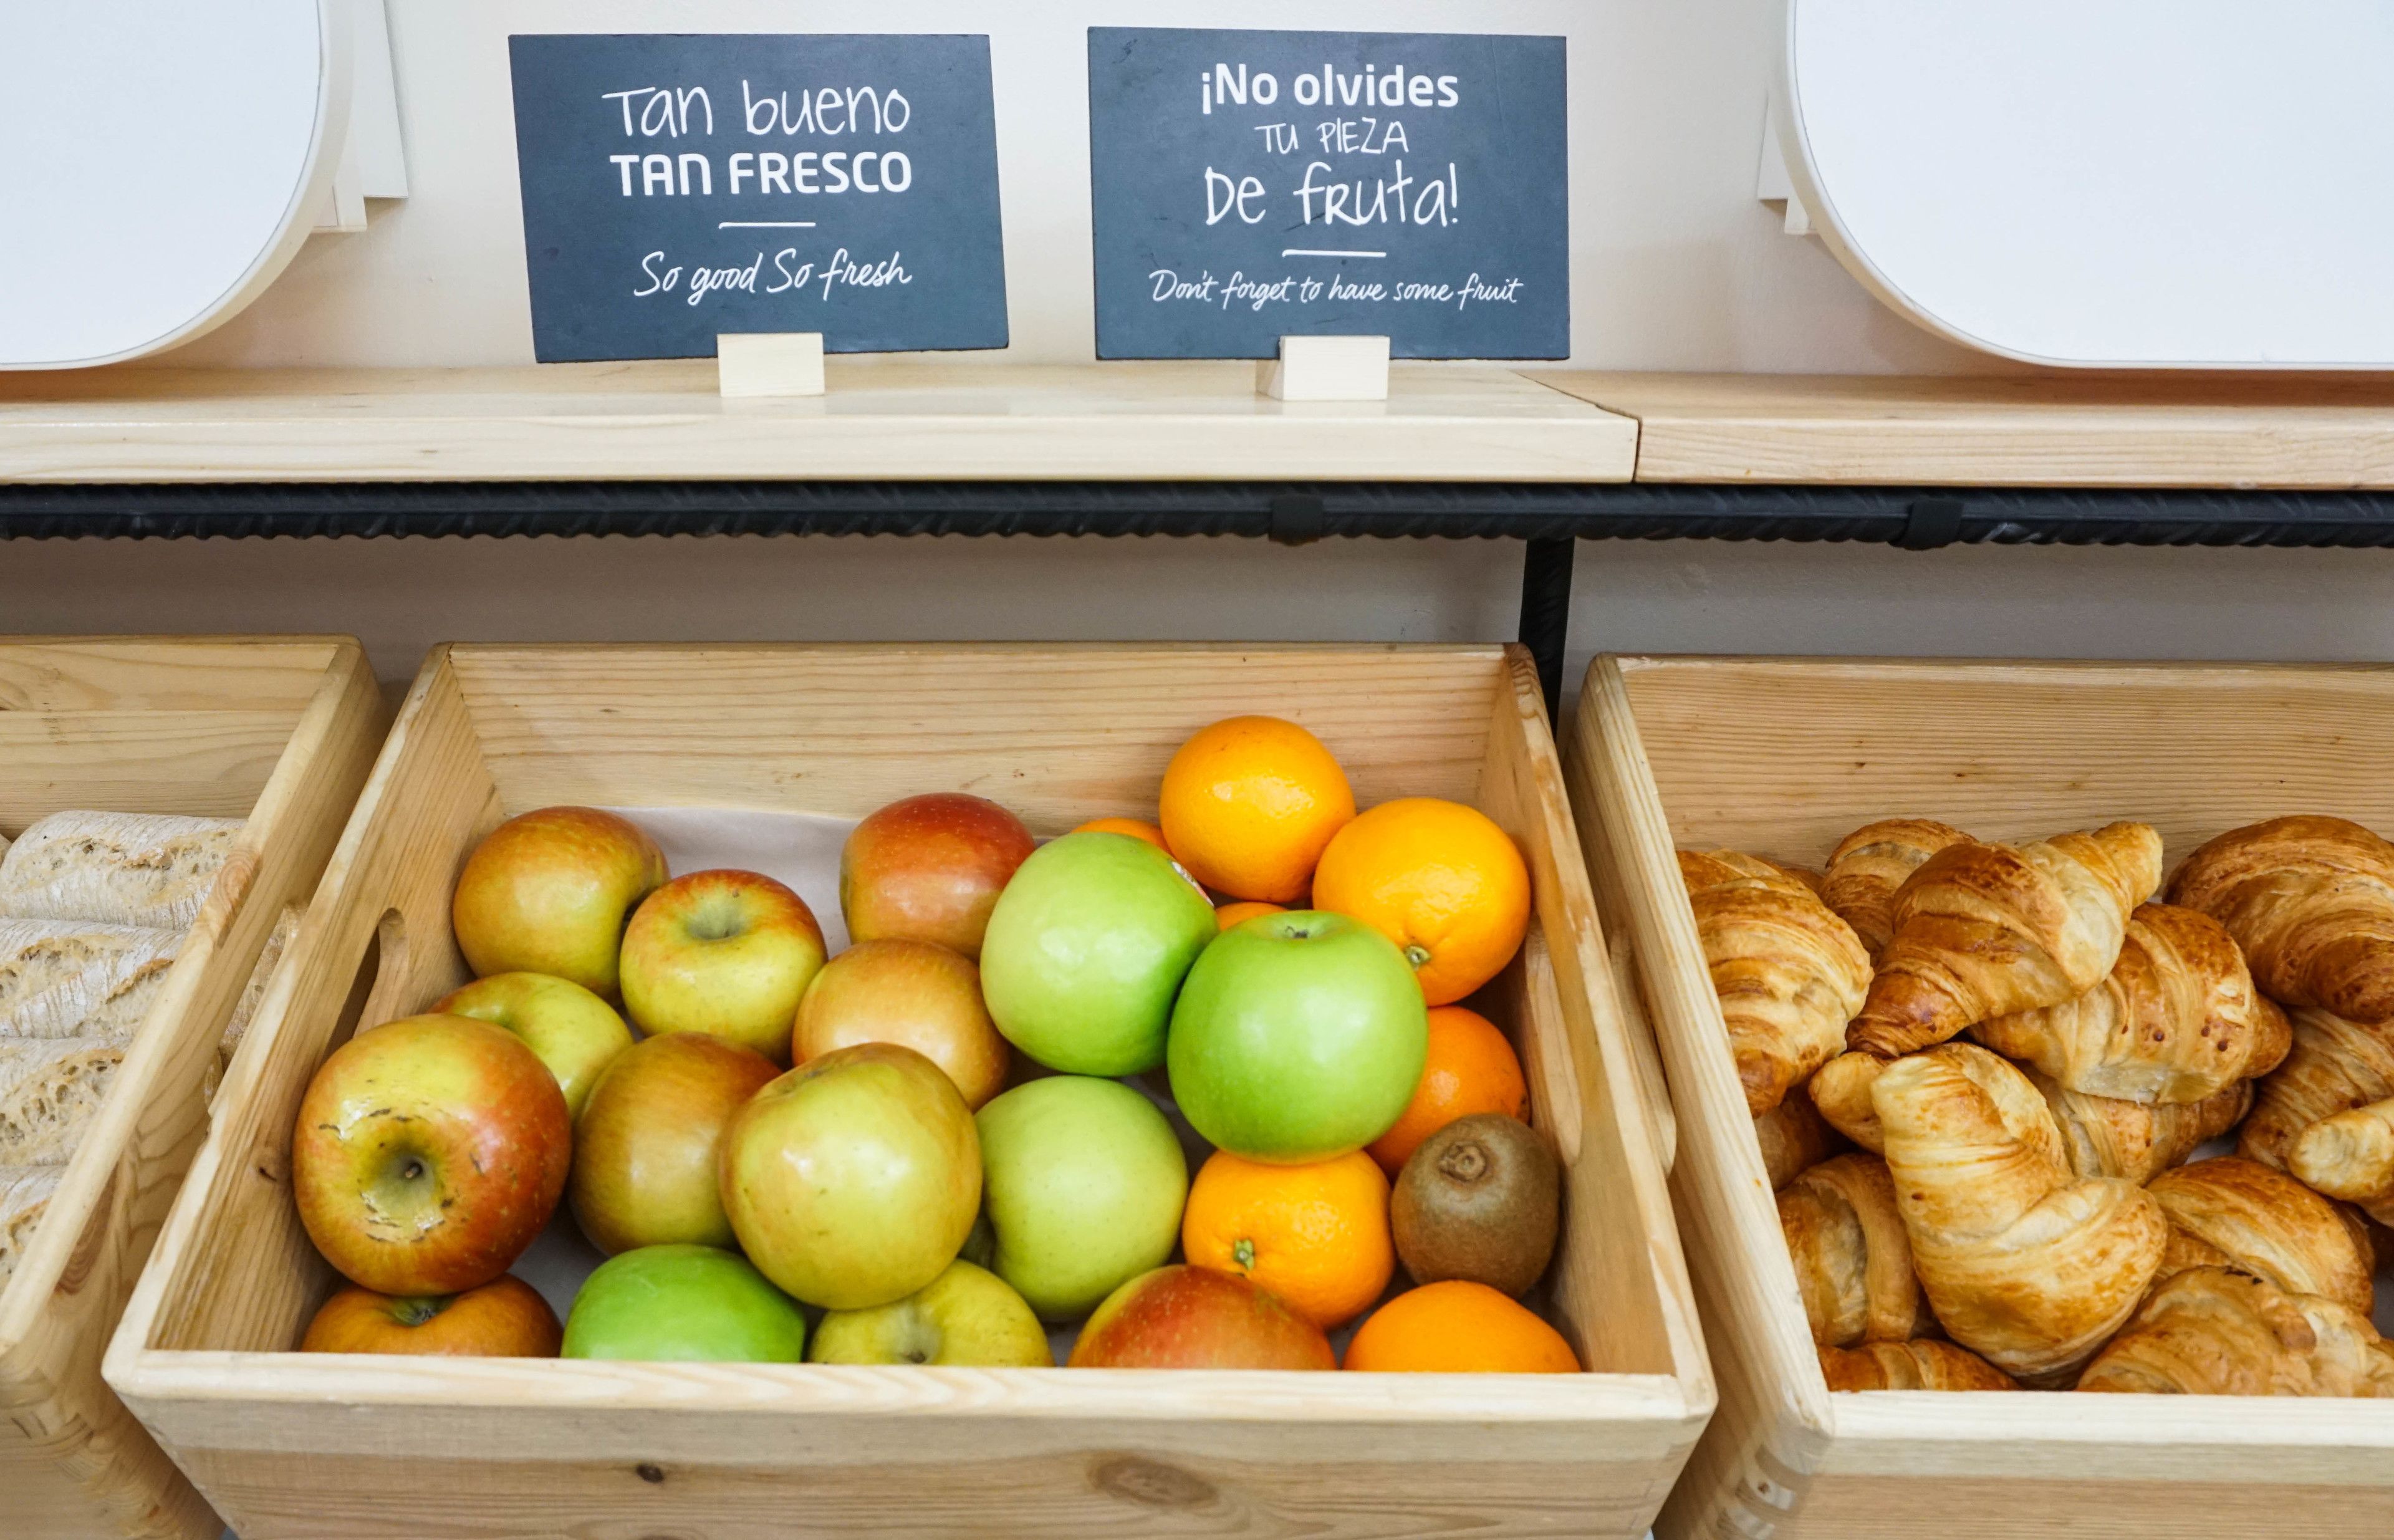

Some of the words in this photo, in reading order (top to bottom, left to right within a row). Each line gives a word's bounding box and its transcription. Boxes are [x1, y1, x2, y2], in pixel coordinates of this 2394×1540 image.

[602, 85, 713, 138] Tan
[741, 79, 911, 136] bueno
[1201, 62, 1279, 115] ¡No
[1292, 62, 1459, 108] olvides
[1253, 123, 1300, 155] TU
[1315, 117, 1409, 155] PIEZA
[609, 153, 712, 196] TAN
[728, 152, 912, 195] FRESCO
[1204, 163, 1267, 226] De
[633, 251, 683, 296] So
[688, 252, 763, 306] good
[766, 248, 815, 294] So
[817, 248, 913, 301] fresh
[1148, 269, 1219, 304] Don't
[1220, 271, 1298, 312] forget
[1299, 276, 1325, 304] to
[1328, 274, 1388, 302] have
[1392, 281, 1454, 302] some
[1457, 272, 1524, 311] fruit
